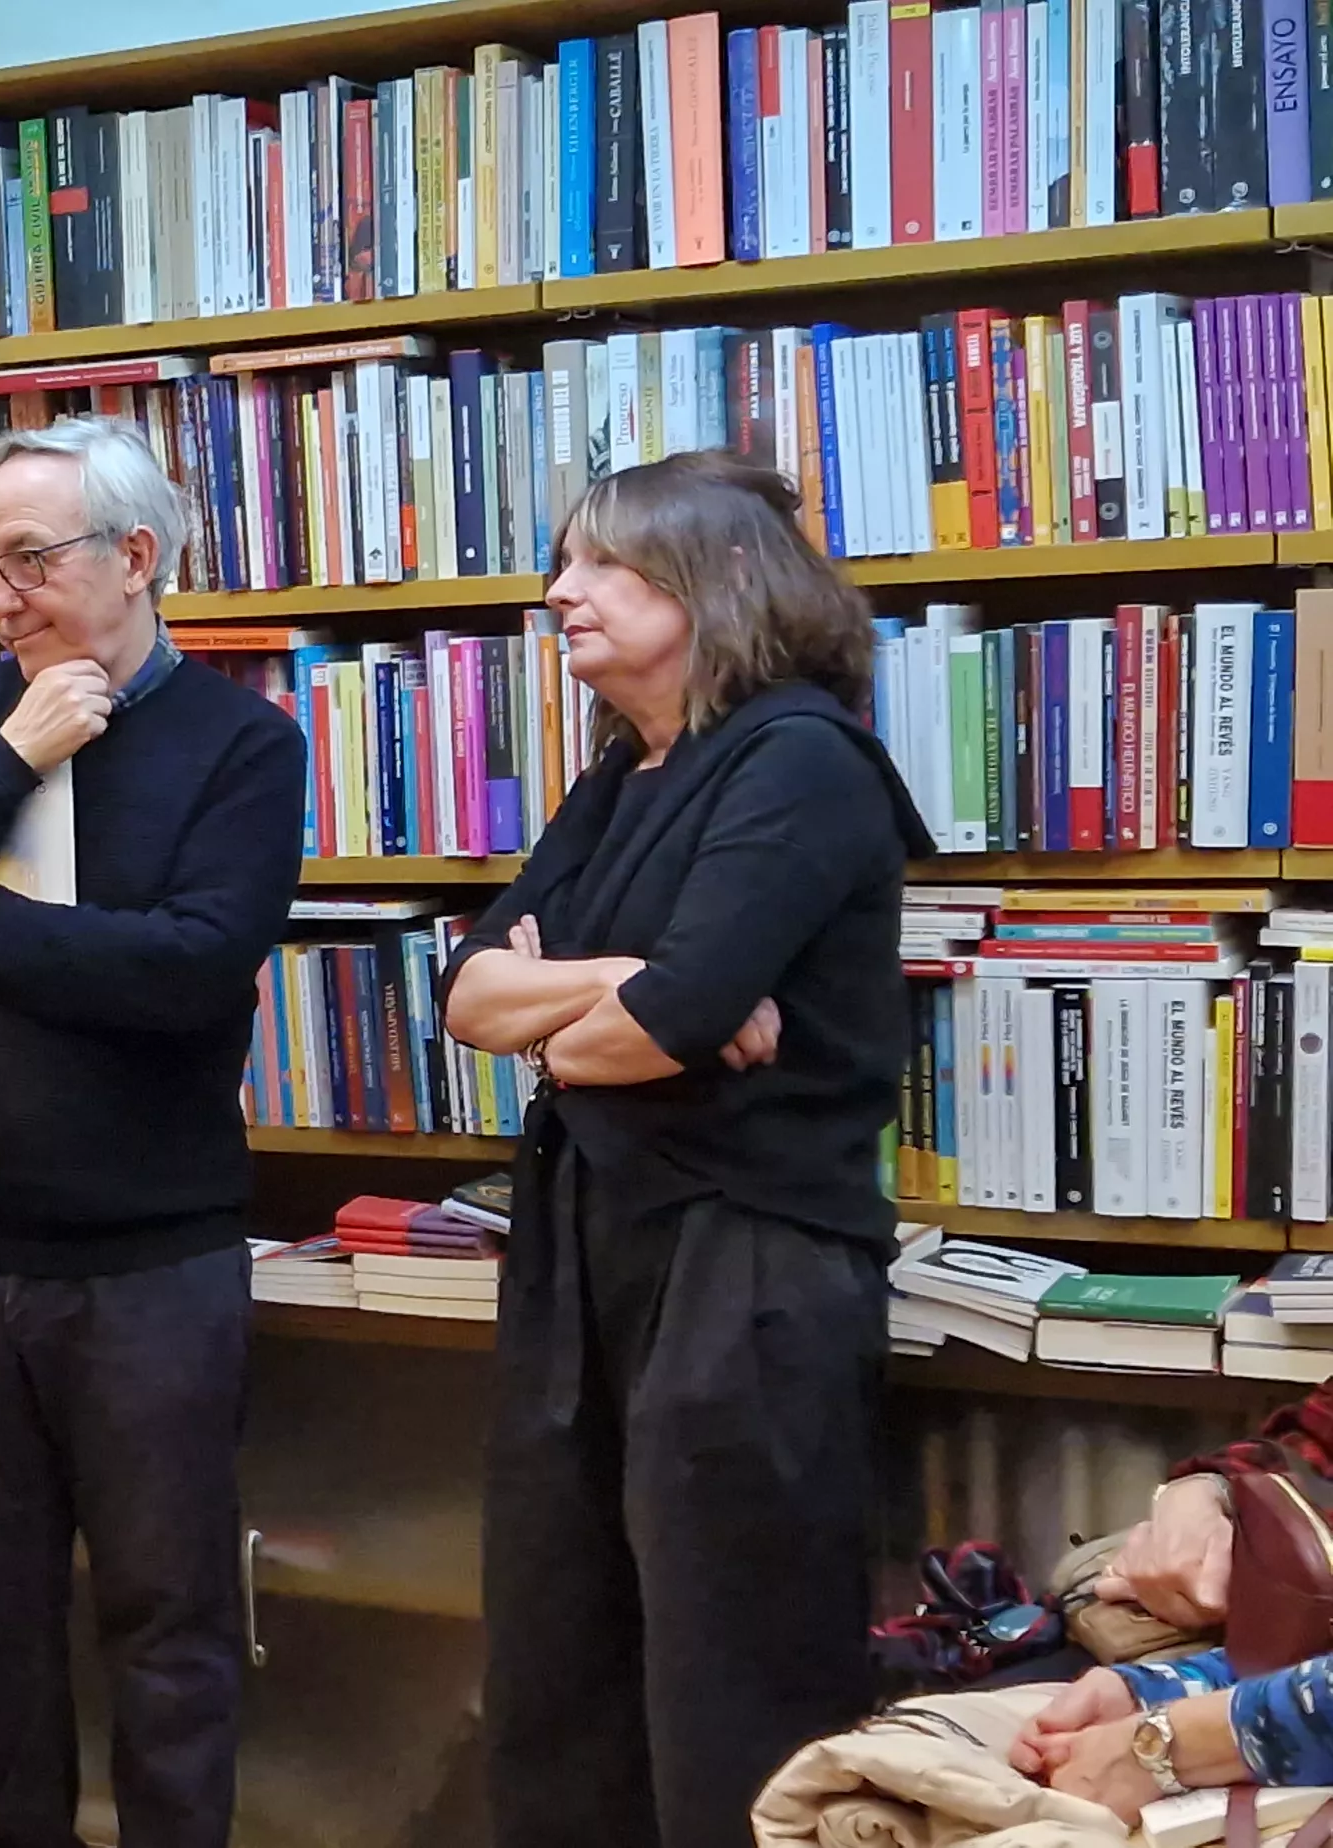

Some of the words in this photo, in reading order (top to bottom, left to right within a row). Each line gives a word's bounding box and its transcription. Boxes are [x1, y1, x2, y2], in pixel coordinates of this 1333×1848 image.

[1179, 0, 1190, 75] INTOLERANCI
[607, 51, 623, 118] CABALLÉ
[1272, 17, 1298, 113] ENSAYO
[30, 198, 43, 240] CIVIL
[1069, 323, 1082, 347] LUZ
[749, 341, 759, 393] HASTINGS
[615, 382, 631, 446] Progreso
[751, 394, 760, 420] MAX
[1221, 625, 1235, 640] EL
[1123, 682, 1136, 693] EL
[1220, 644, 1235, 691] MUNDO
[1123, 696, 1136, 743] MUNDO
[1219, 696, 1234, 711] AL
[1218, 716, 1236, 757] REVÉS
[1171, 1001, 1185, 1015] EL
[1170, 1020, 1185, 1066] MUNDO
[1170, 1070, 1184, 1085] AL
[1170, 1089, 1187, 1130] REVÉS
